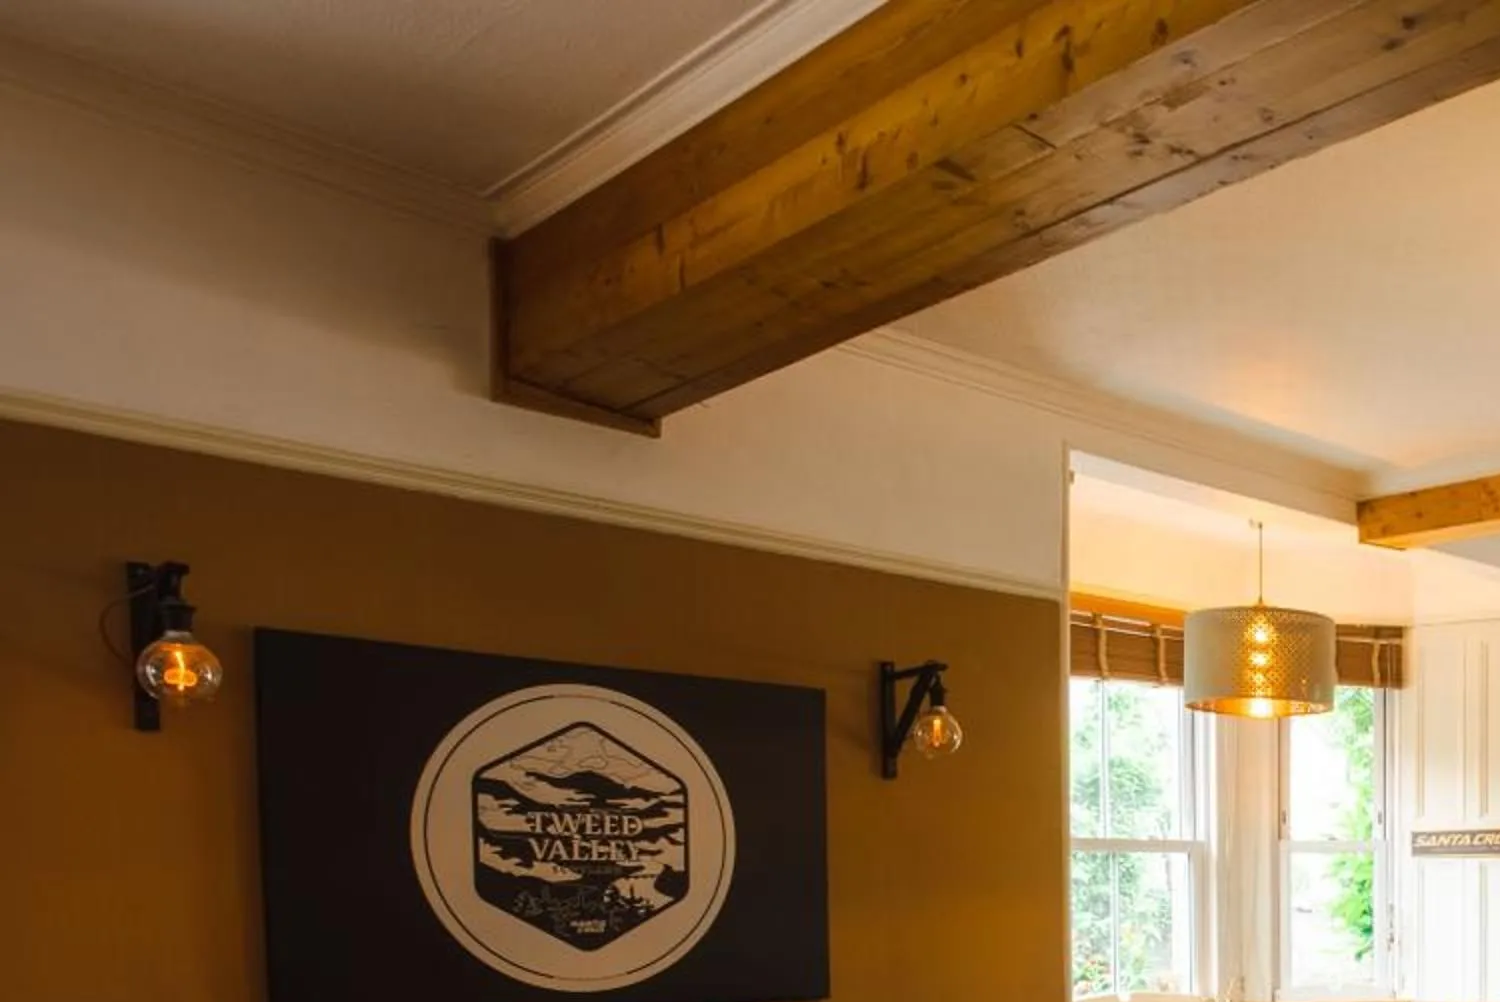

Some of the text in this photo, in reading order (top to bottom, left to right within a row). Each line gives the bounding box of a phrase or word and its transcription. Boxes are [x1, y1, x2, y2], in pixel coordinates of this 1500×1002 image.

[528, 811, 643, 836] TWEED
[528, 837, 640, 861] VALLEY
[1414, 833, 1470, 846] SANTA
